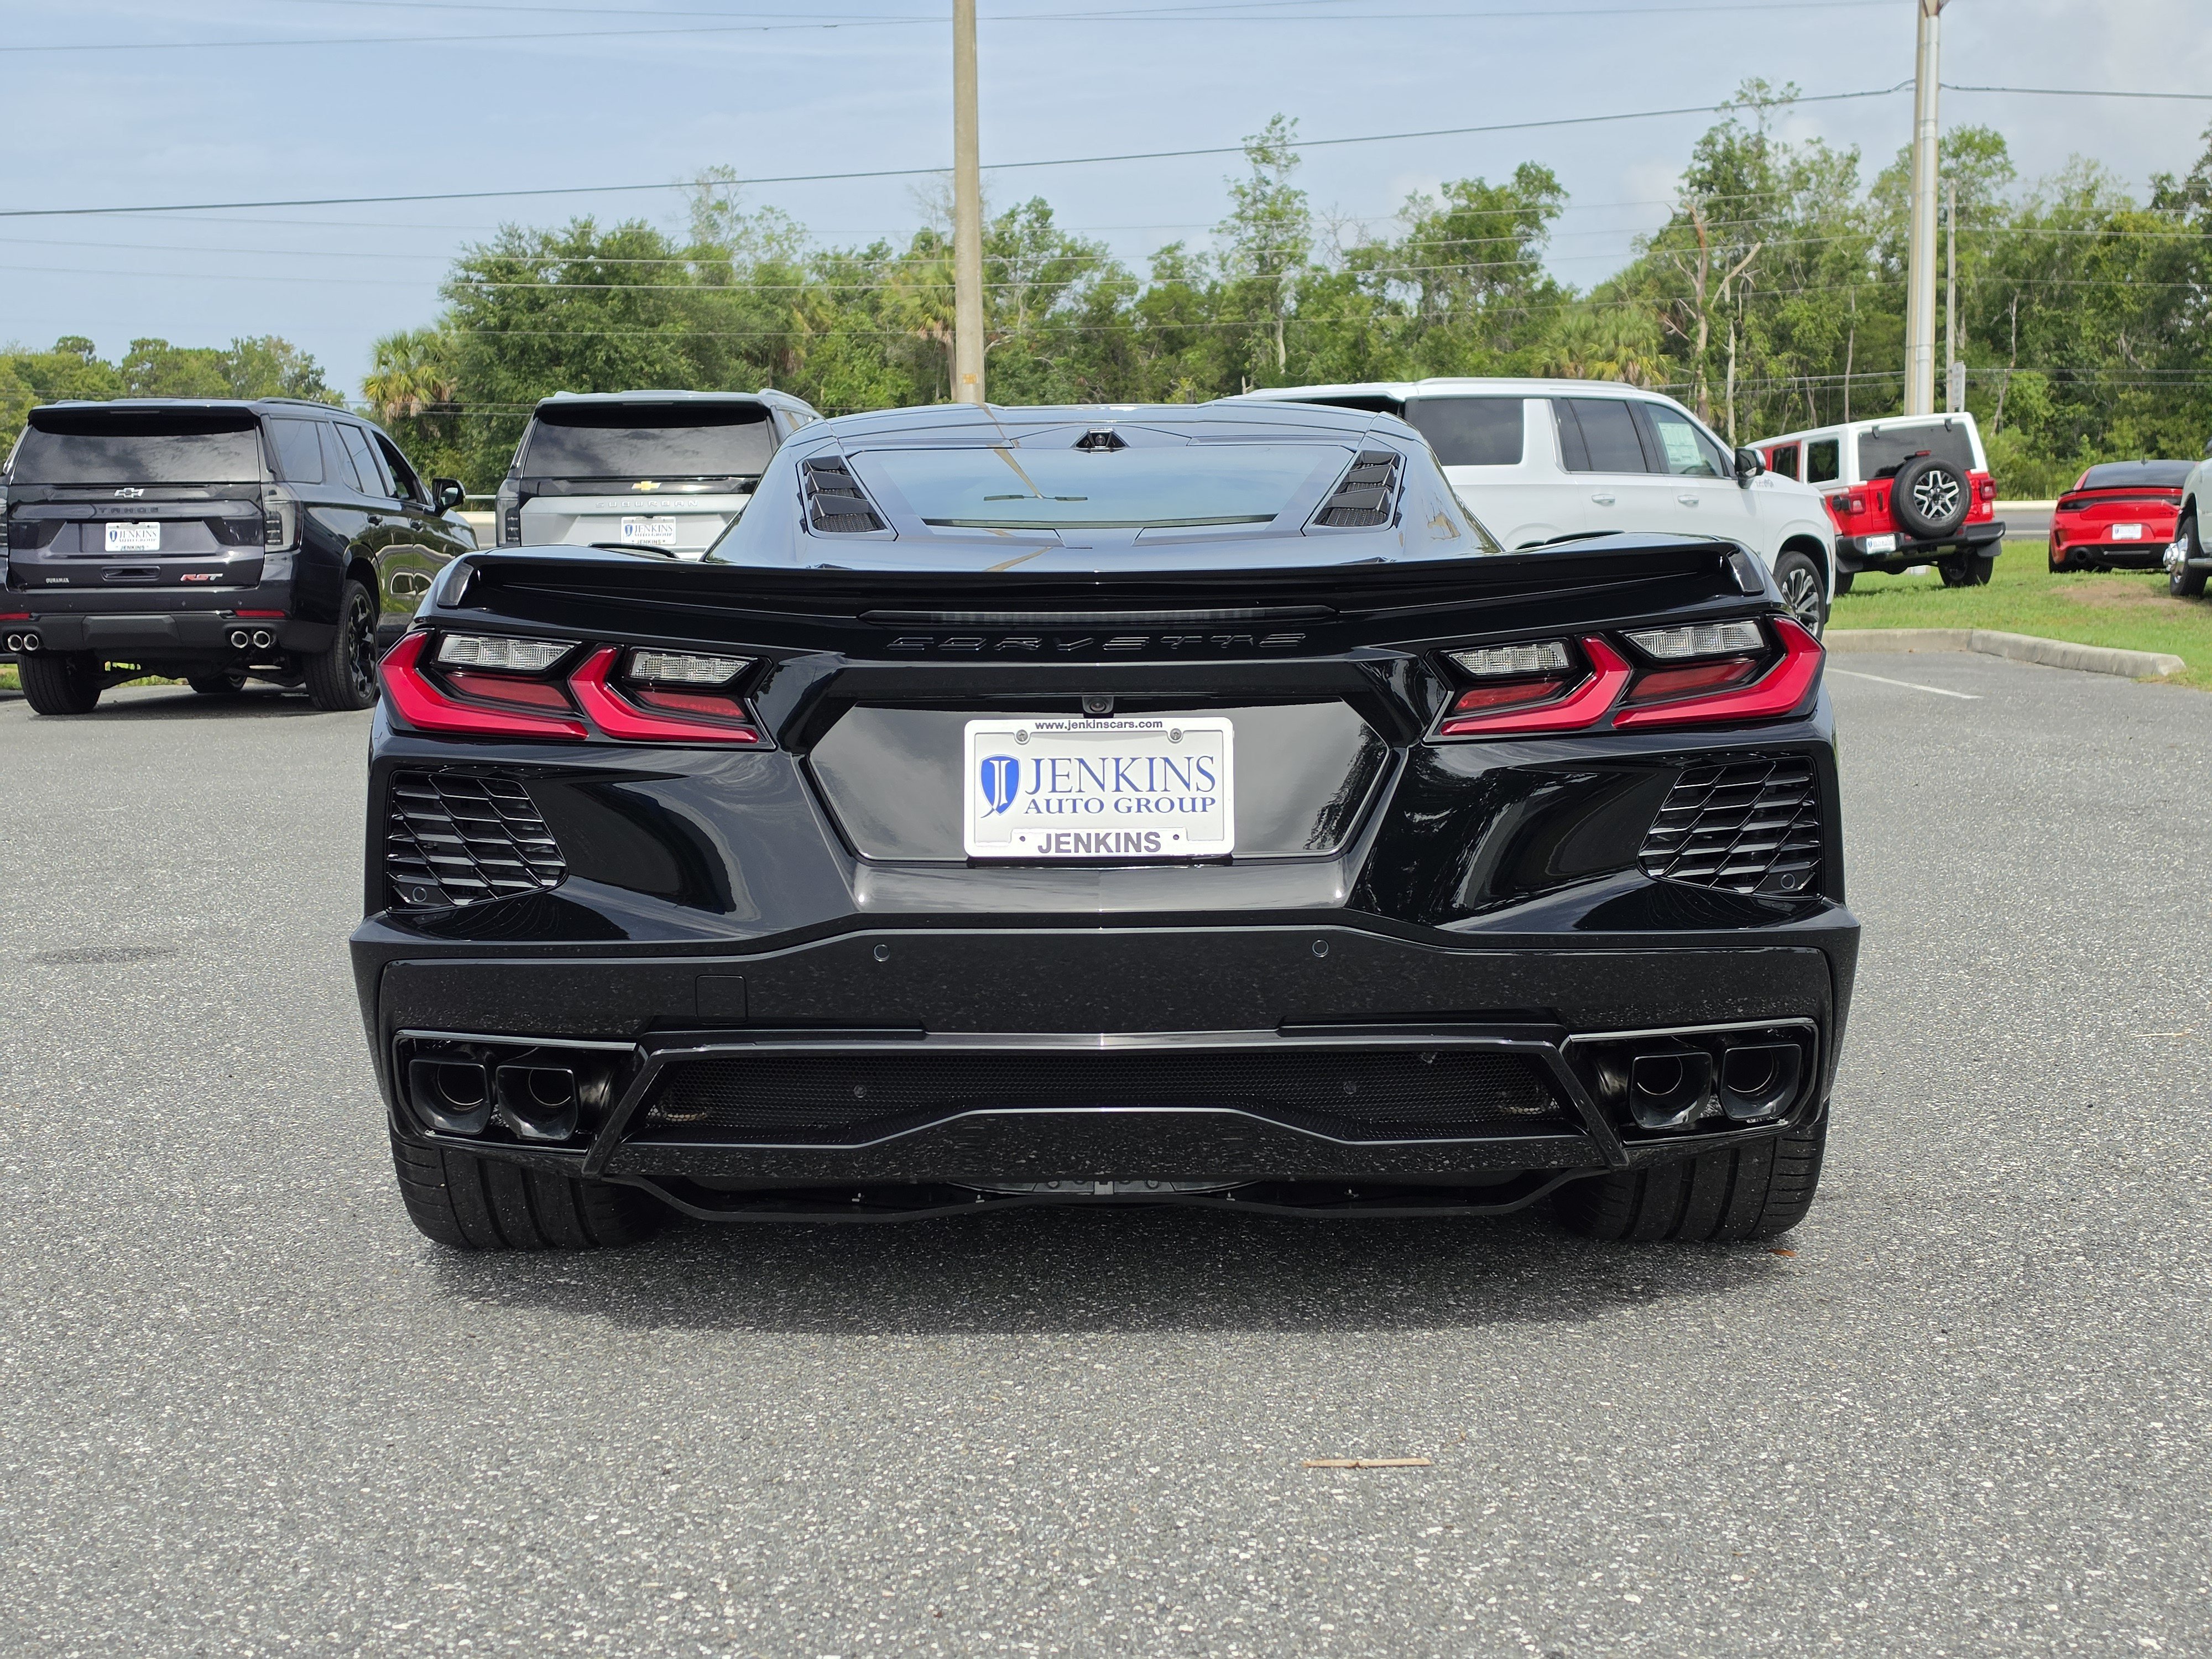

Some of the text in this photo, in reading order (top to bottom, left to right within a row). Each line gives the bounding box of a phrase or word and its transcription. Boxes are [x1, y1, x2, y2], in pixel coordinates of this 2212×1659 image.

[119, 530, 156, 538] JENKINS
[635, 524, 672, 533] JENKINS
[886, 633, 1306, 651] CORVETTE
[1035, 719, 1164, 731] www.jenkinscars.com
[1024, 755, 1216, 795] JENKINS
[1023, 796, 1217, 815] AUTO GROUP
[1037, 831, 1162, 854] JENKINS
